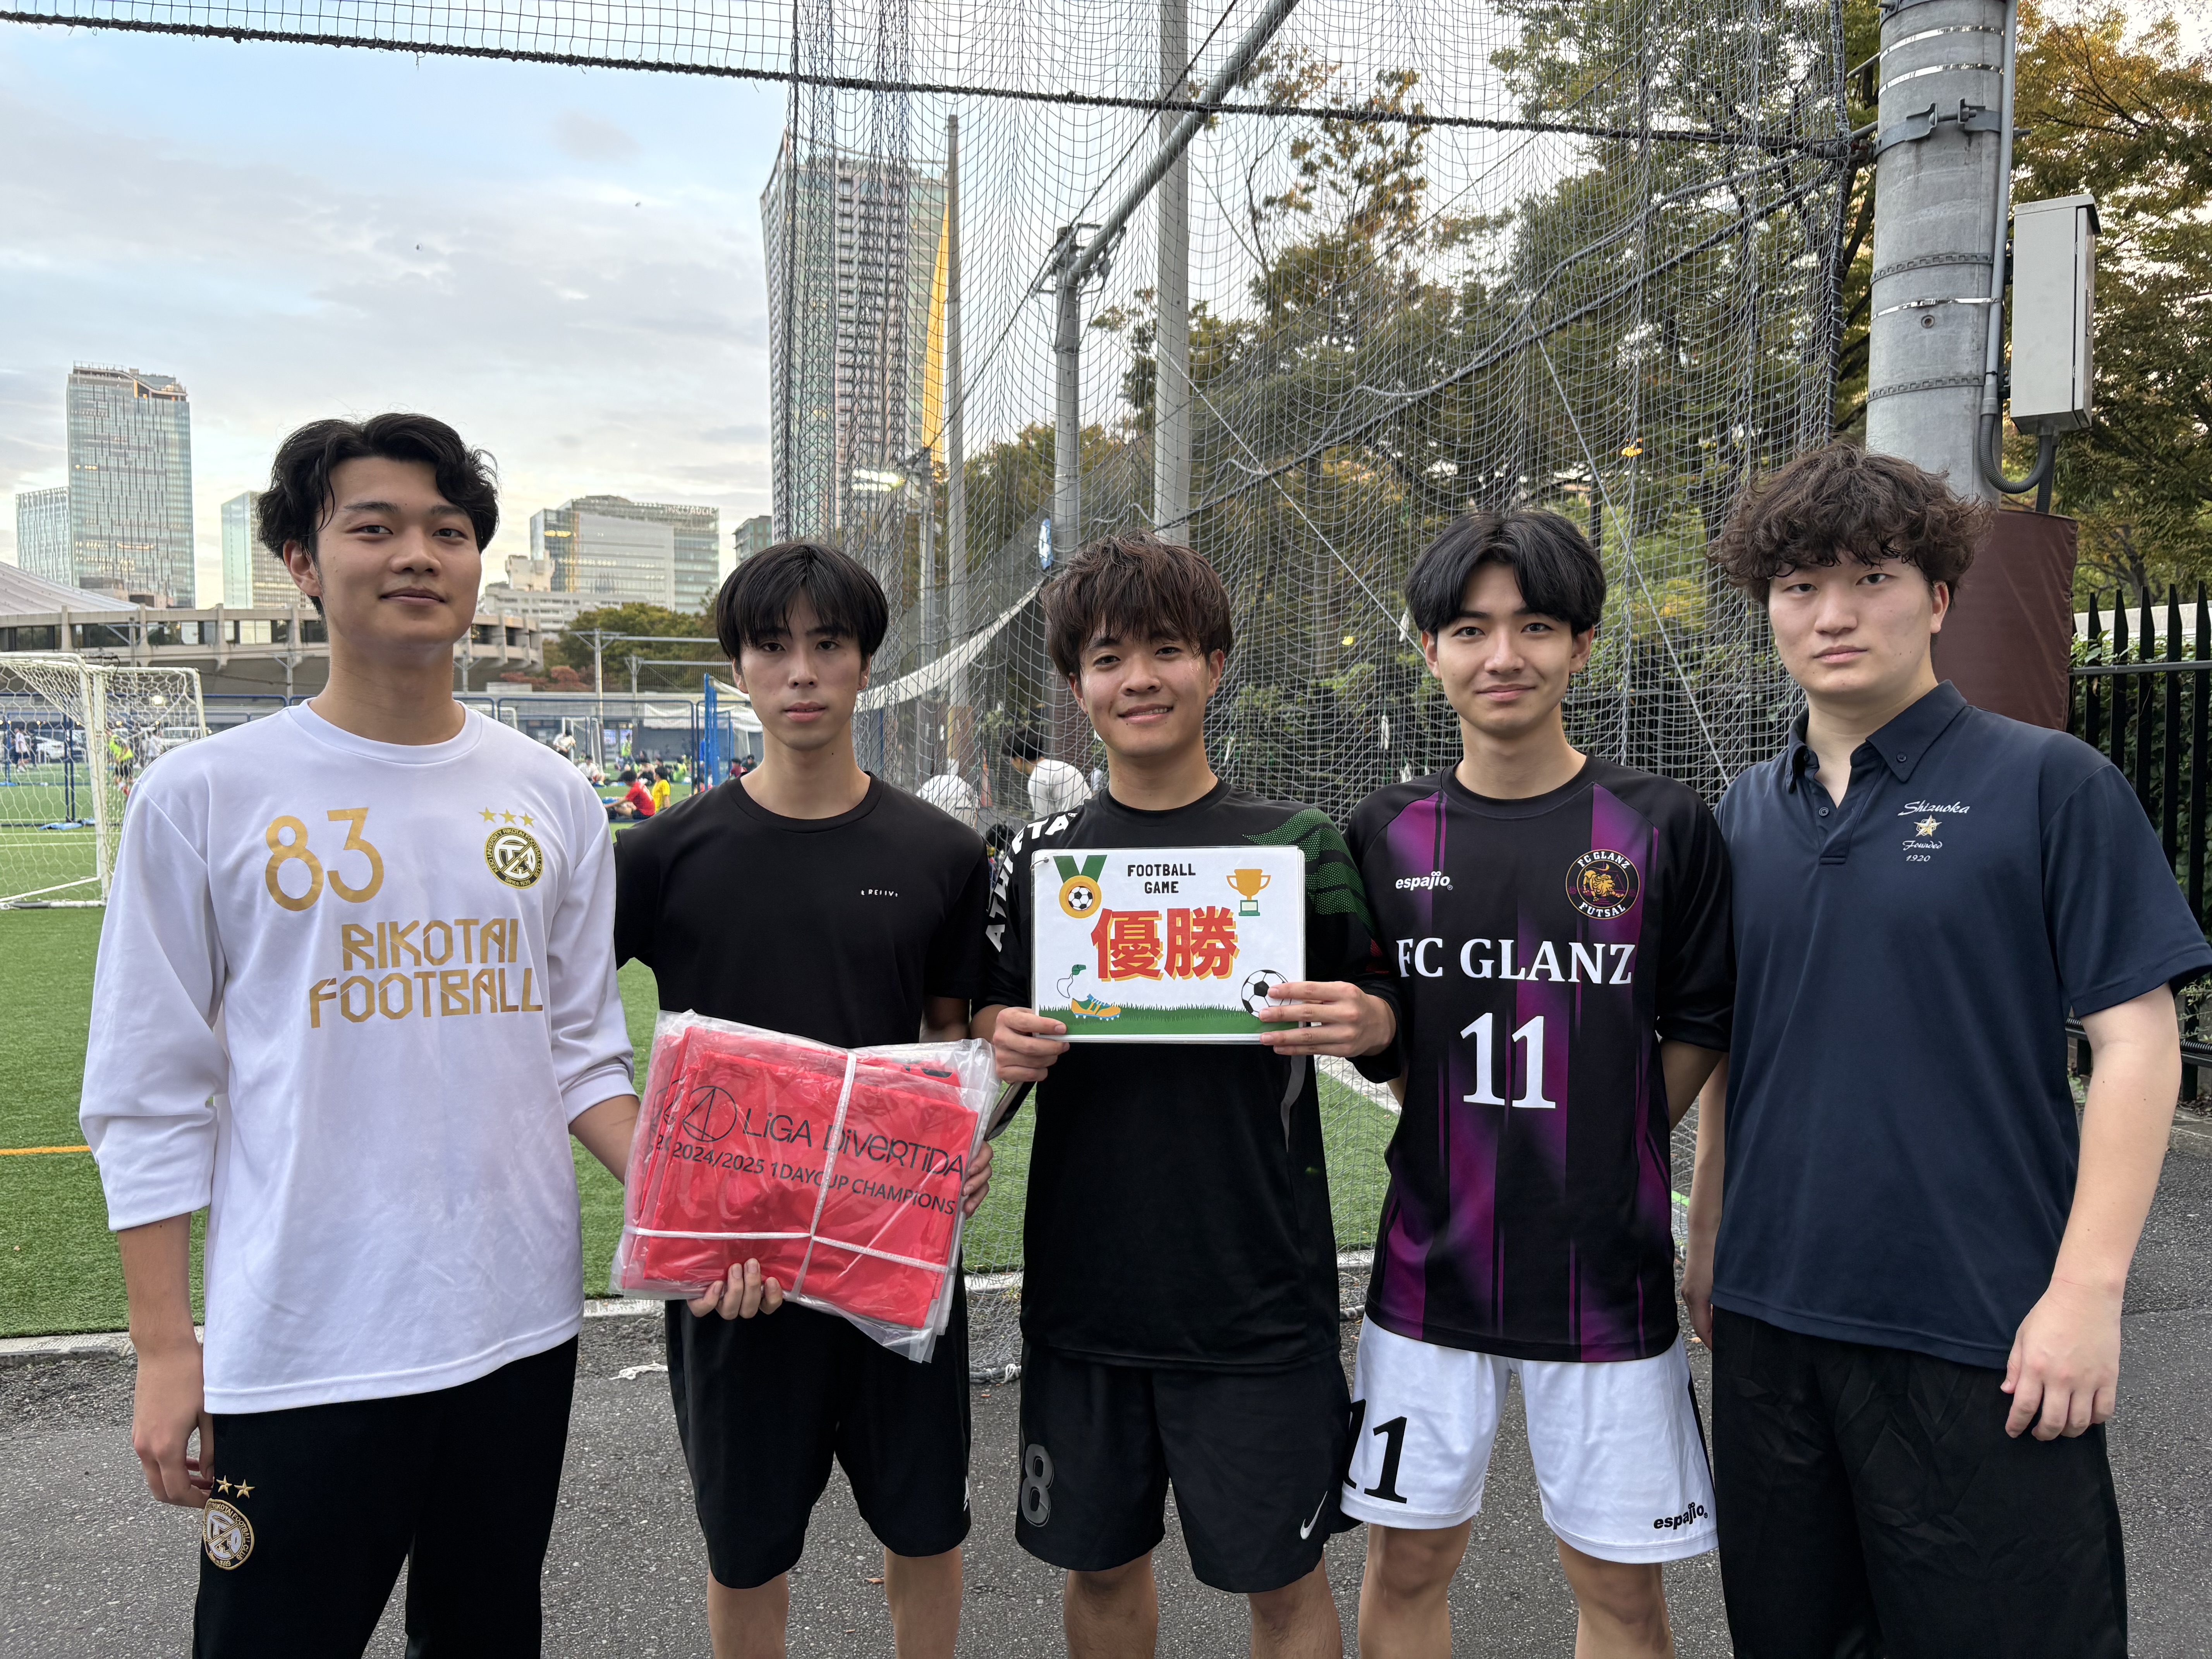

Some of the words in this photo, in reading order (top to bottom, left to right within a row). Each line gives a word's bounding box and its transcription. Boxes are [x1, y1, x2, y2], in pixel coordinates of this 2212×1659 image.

[1898, 800, 1970, 816] Shizuoka
[486, 830, 502, 857] UNIVERSITY
[525, 834, 542, 862] FOOTBALL
[1902, 840, 1942, 851] Founded
[265, 807, 384, 911] 83
[488, 859, 499, 873] KEIO
[534, 862, 542, 878] CLUB
[1127, 863, 1196, 877] FOOTBALL
[1577, 855, 1592, 867] FC
[1593, 851, 1630, 869] GLANZ
[1144, 881, 1179, 894] GAME
[1579, 902, 1626, 917] FUTSAL
[342, 918, 518, 971] RIKOTAI
[1091, 905, 1240, 982] 優勝
[1396, 937, 1443, 978] FC
[1460, 938, 1635, 984] GLANZ
[310, 968, 543, 1029] FOOTBALL
[1460, 1012, 1556, 1109] 11
[673, 1142, 765, 1174] 2024/2025
[852, 1178, 956, 1215] CHAMPIONS
[1020, 1433, 1054, 1527] 8
